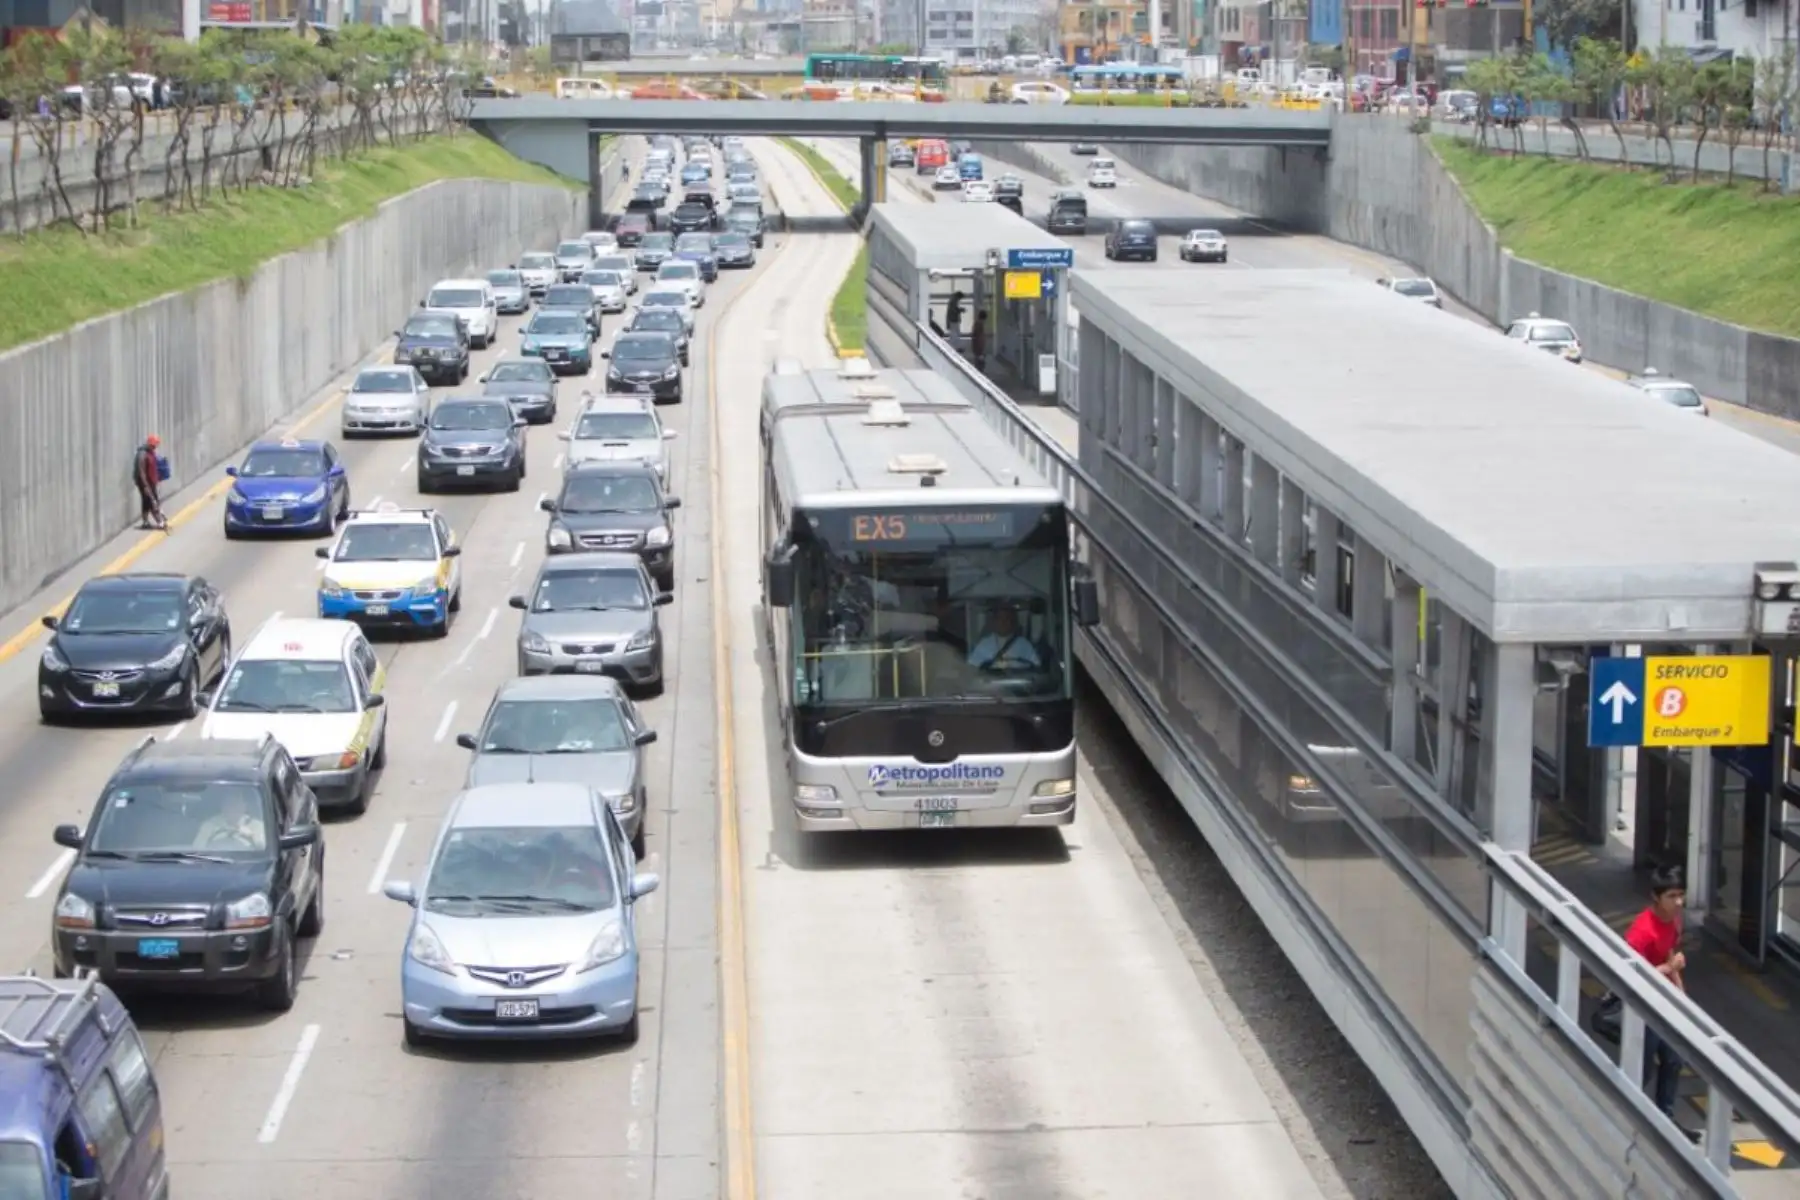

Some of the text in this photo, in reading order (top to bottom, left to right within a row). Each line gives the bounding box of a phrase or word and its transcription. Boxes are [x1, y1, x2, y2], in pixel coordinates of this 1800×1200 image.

[855, 514, 906, 540] EX5
[1655, 664, 1728, 679] SERVICIO
[1660, 688, 1682, 717] B
[1653, 726, 1733, 740] Embarque 2
[868, 764, 1005, 786] Metropolitano
[914, 798, 958, 809] 41003
